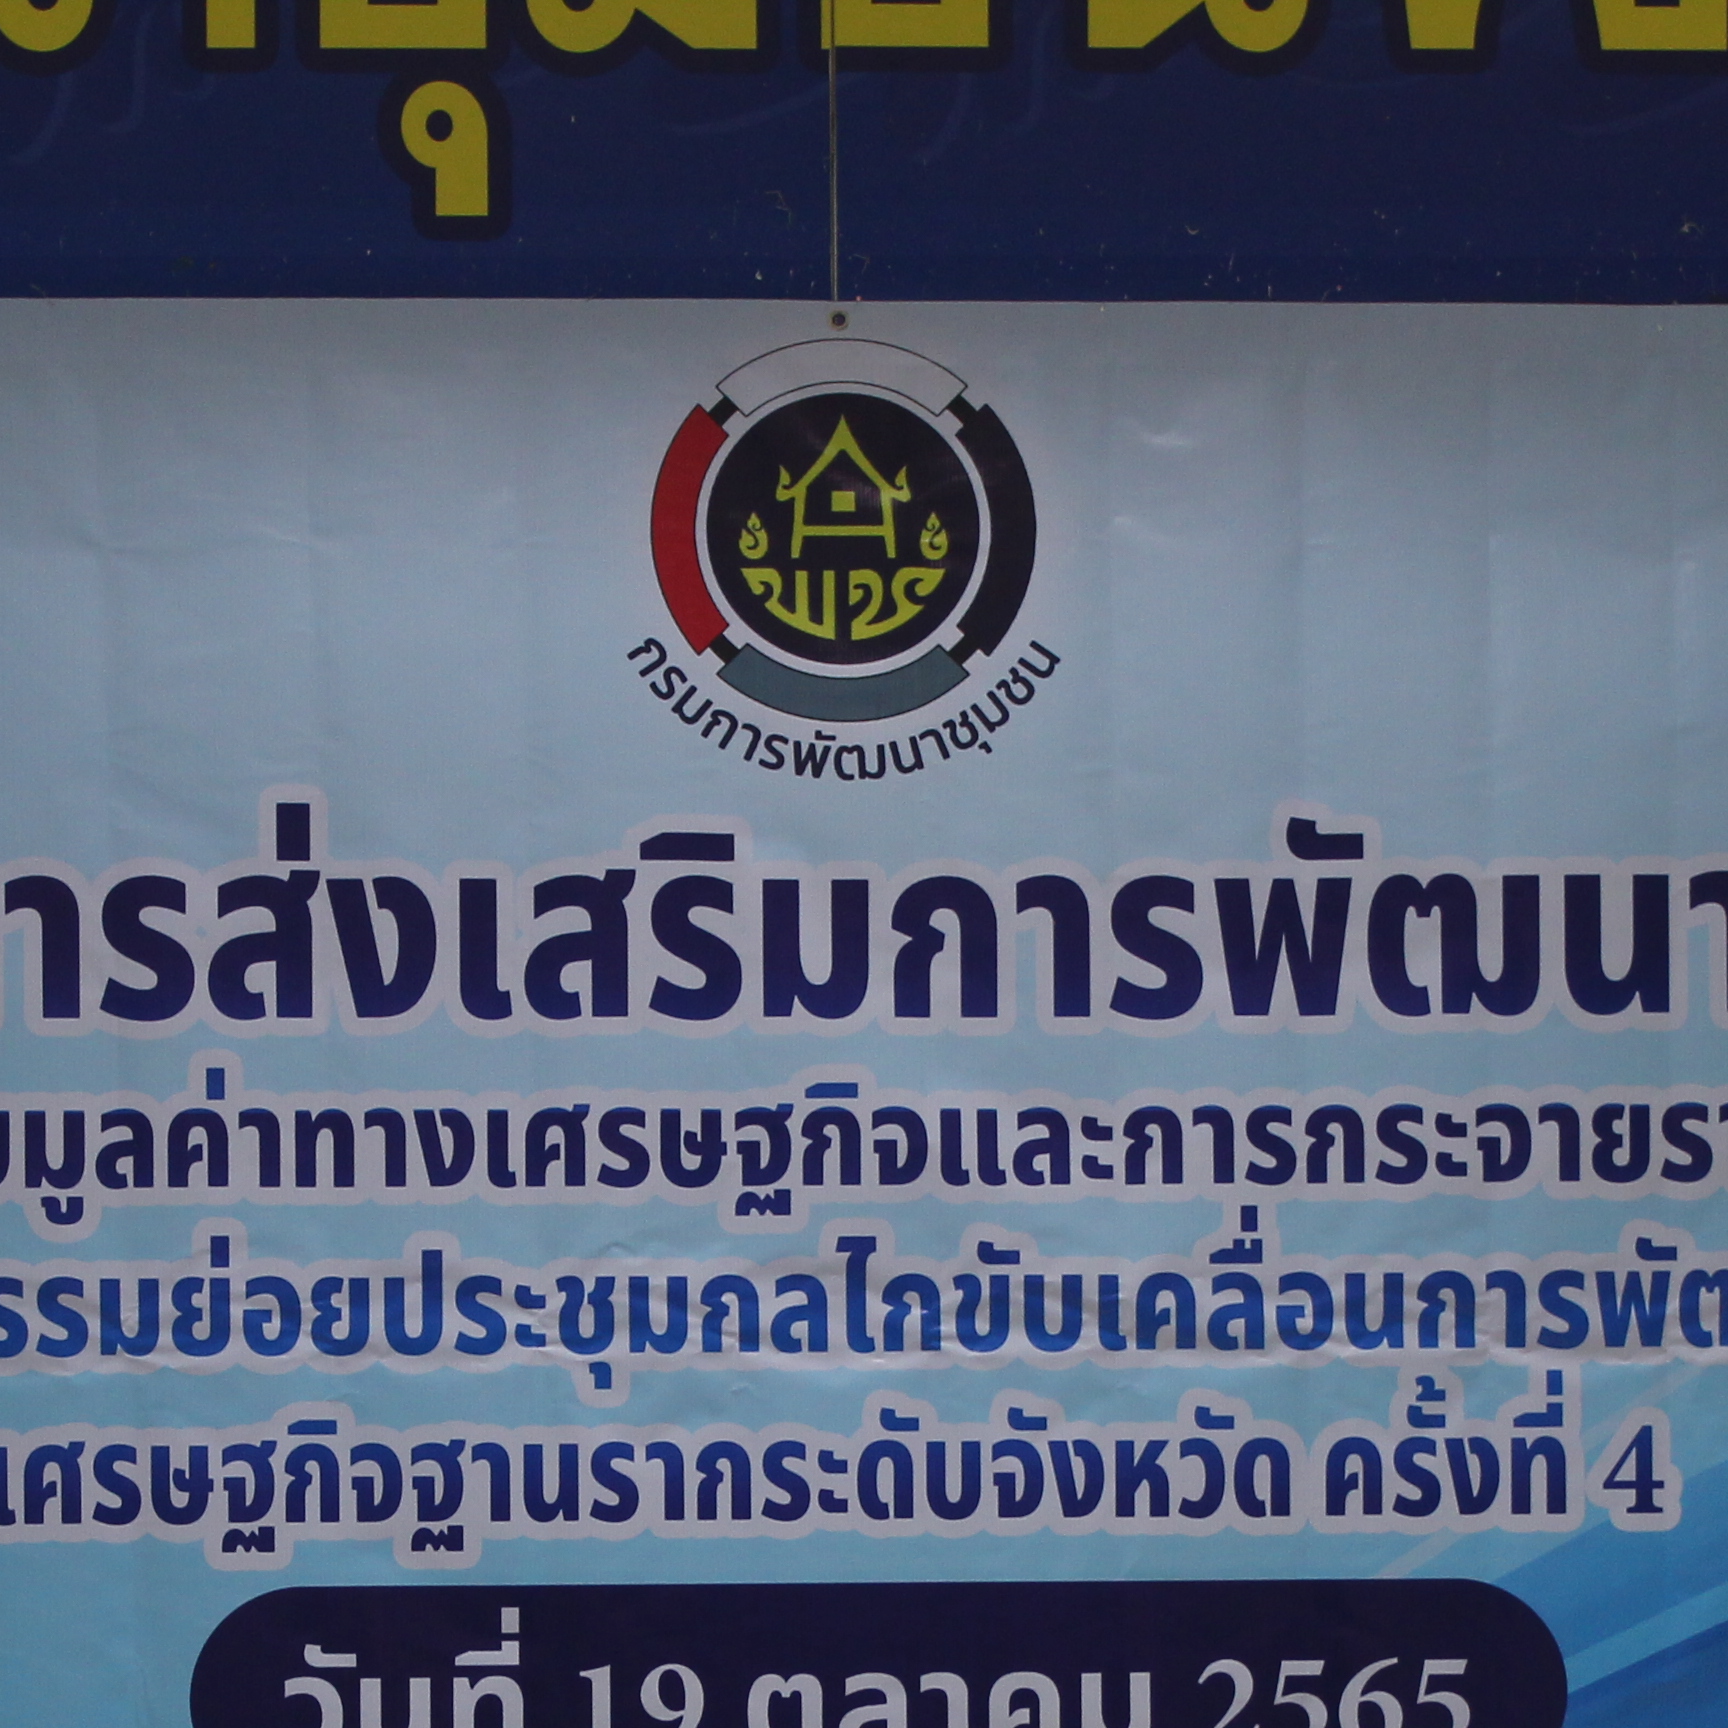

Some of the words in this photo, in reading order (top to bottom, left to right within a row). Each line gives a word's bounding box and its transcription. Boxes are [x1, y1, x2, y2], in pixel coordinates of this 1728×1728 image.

[627, 637, 1062, 782] กรมการพัฒนาชุมชน
[1324, 1372, 1568, 1518] ครั้งที่
[1602, 1423, 1666, 1514] 4
